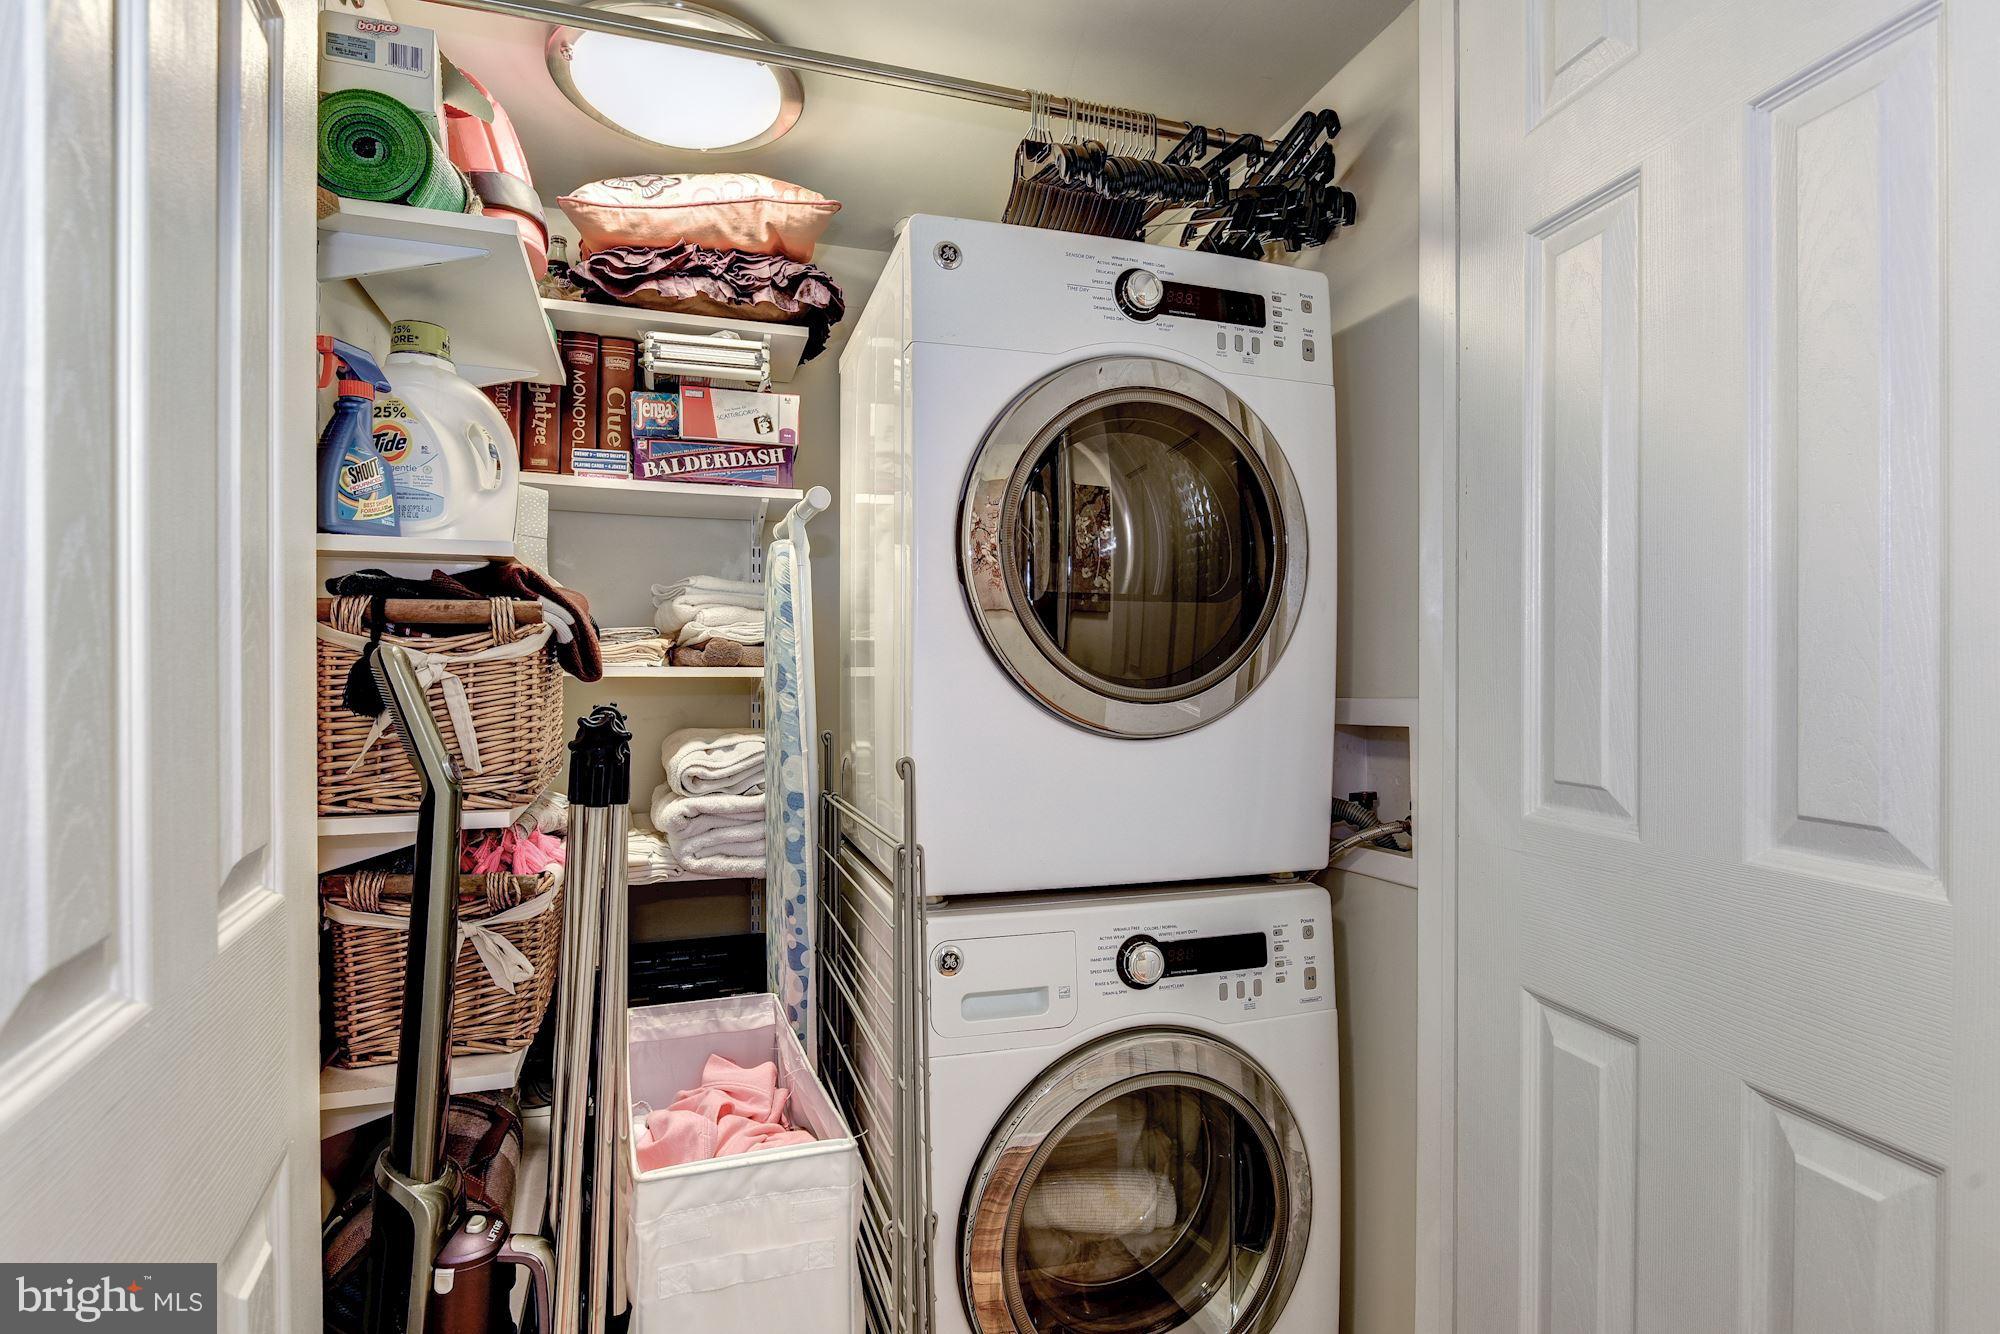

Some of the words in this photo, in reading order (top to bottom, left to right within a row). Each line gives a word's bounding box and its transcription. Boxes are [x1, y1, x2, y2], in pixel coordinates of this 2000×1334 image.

[357, 20, 398, 33] bounce
[373, 406, 407, 419] 25%
[572, 369, 587, 448] MONOPOL
[606, 386, 627, 448] Clue
[634, 398, 675, 428] Jenga
[372, 432, 408, 454] Tide
[347, 459, 379, 484] SHOUT
[642, 447, 787, 479] BALDERDASH
